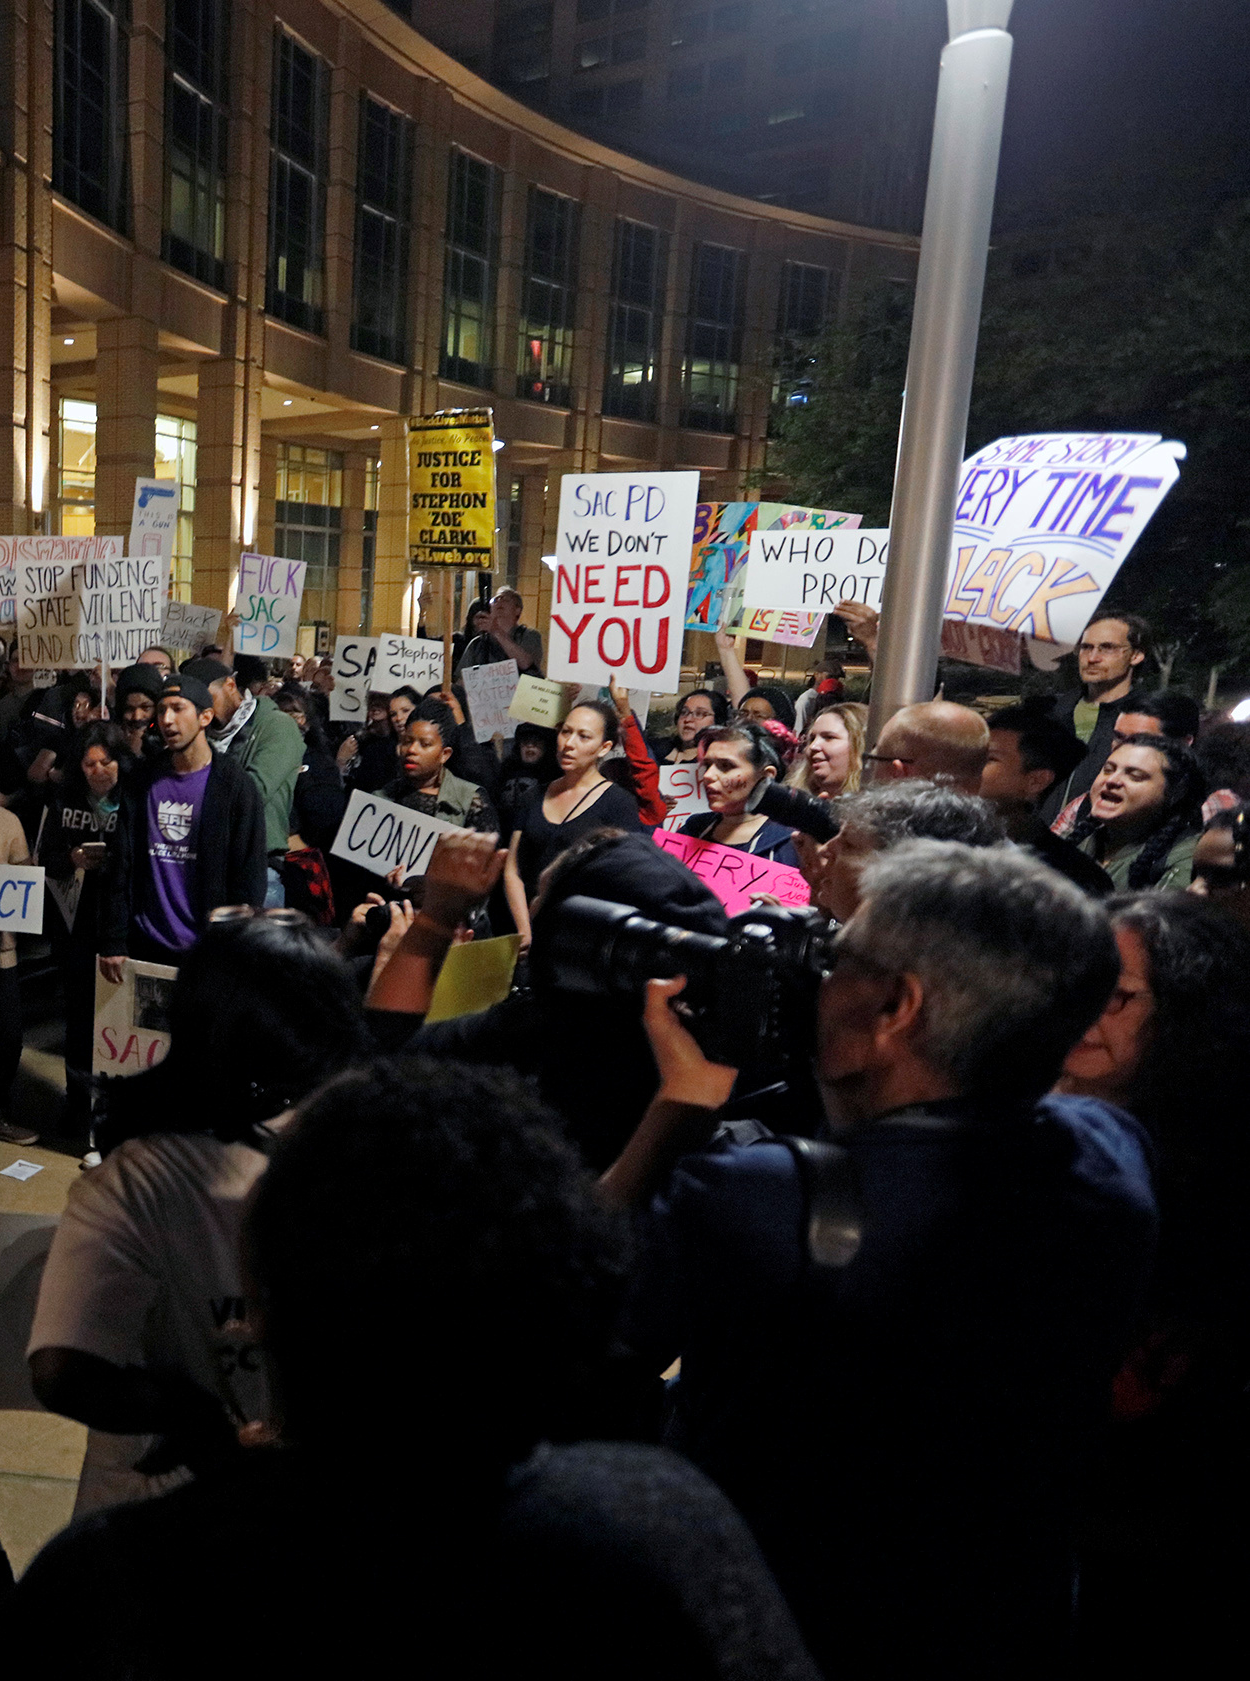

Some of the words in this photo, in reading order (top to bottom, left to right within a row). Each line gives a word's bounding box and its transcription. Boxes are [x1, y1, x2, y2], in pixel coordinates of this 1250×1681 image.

[417, 451, 482, 467] JUSTICE
[977, 437, 1061, 465] SAME
[1047, 436, 1152, 468] STORY
[431, 472, 462, 487] FOR
[412, 492, 487, 509] STEPHON
[574, 484, 617, 517] SAC
[625, 485, 666, 522] PD
[957, 468, 1039, 527] VERY
[1029, 471, 1164, 541] TIME
[152, 520, 170, 528] GUN
[428, 511, 465, 526] 'ZOE'
[419, 530, 477, 545] CLARK!
[565, 529, 599, 552] WE
[608, 530, 668, 556] DON'T
[761, 536, 834, 564] WHO
[411, 548, 491, 567] PSLweb.org
[25, 567, 65, 593] STOP
[72, 560, 159, 591] FUNDING
[240, 555, 302, 598] FUCK
[557, 564, 671, 608] NEED
[802, 573, 882, 604] PROT
[945, 545, 1100, 644] LACK
[23, 596, 74, 629] STATE
[166, 602, 216, 630] Black
[240, 595, 286, 623] SAC
[21, 635, 62, 664] FUND
[239, 622, 280, 651] PD
[551, 613, 670, 674] YOU
[389, 664, 440, 680] Clark
[158, 813, 192, 827] SAC
[347, 803, 440, 873] CONV
